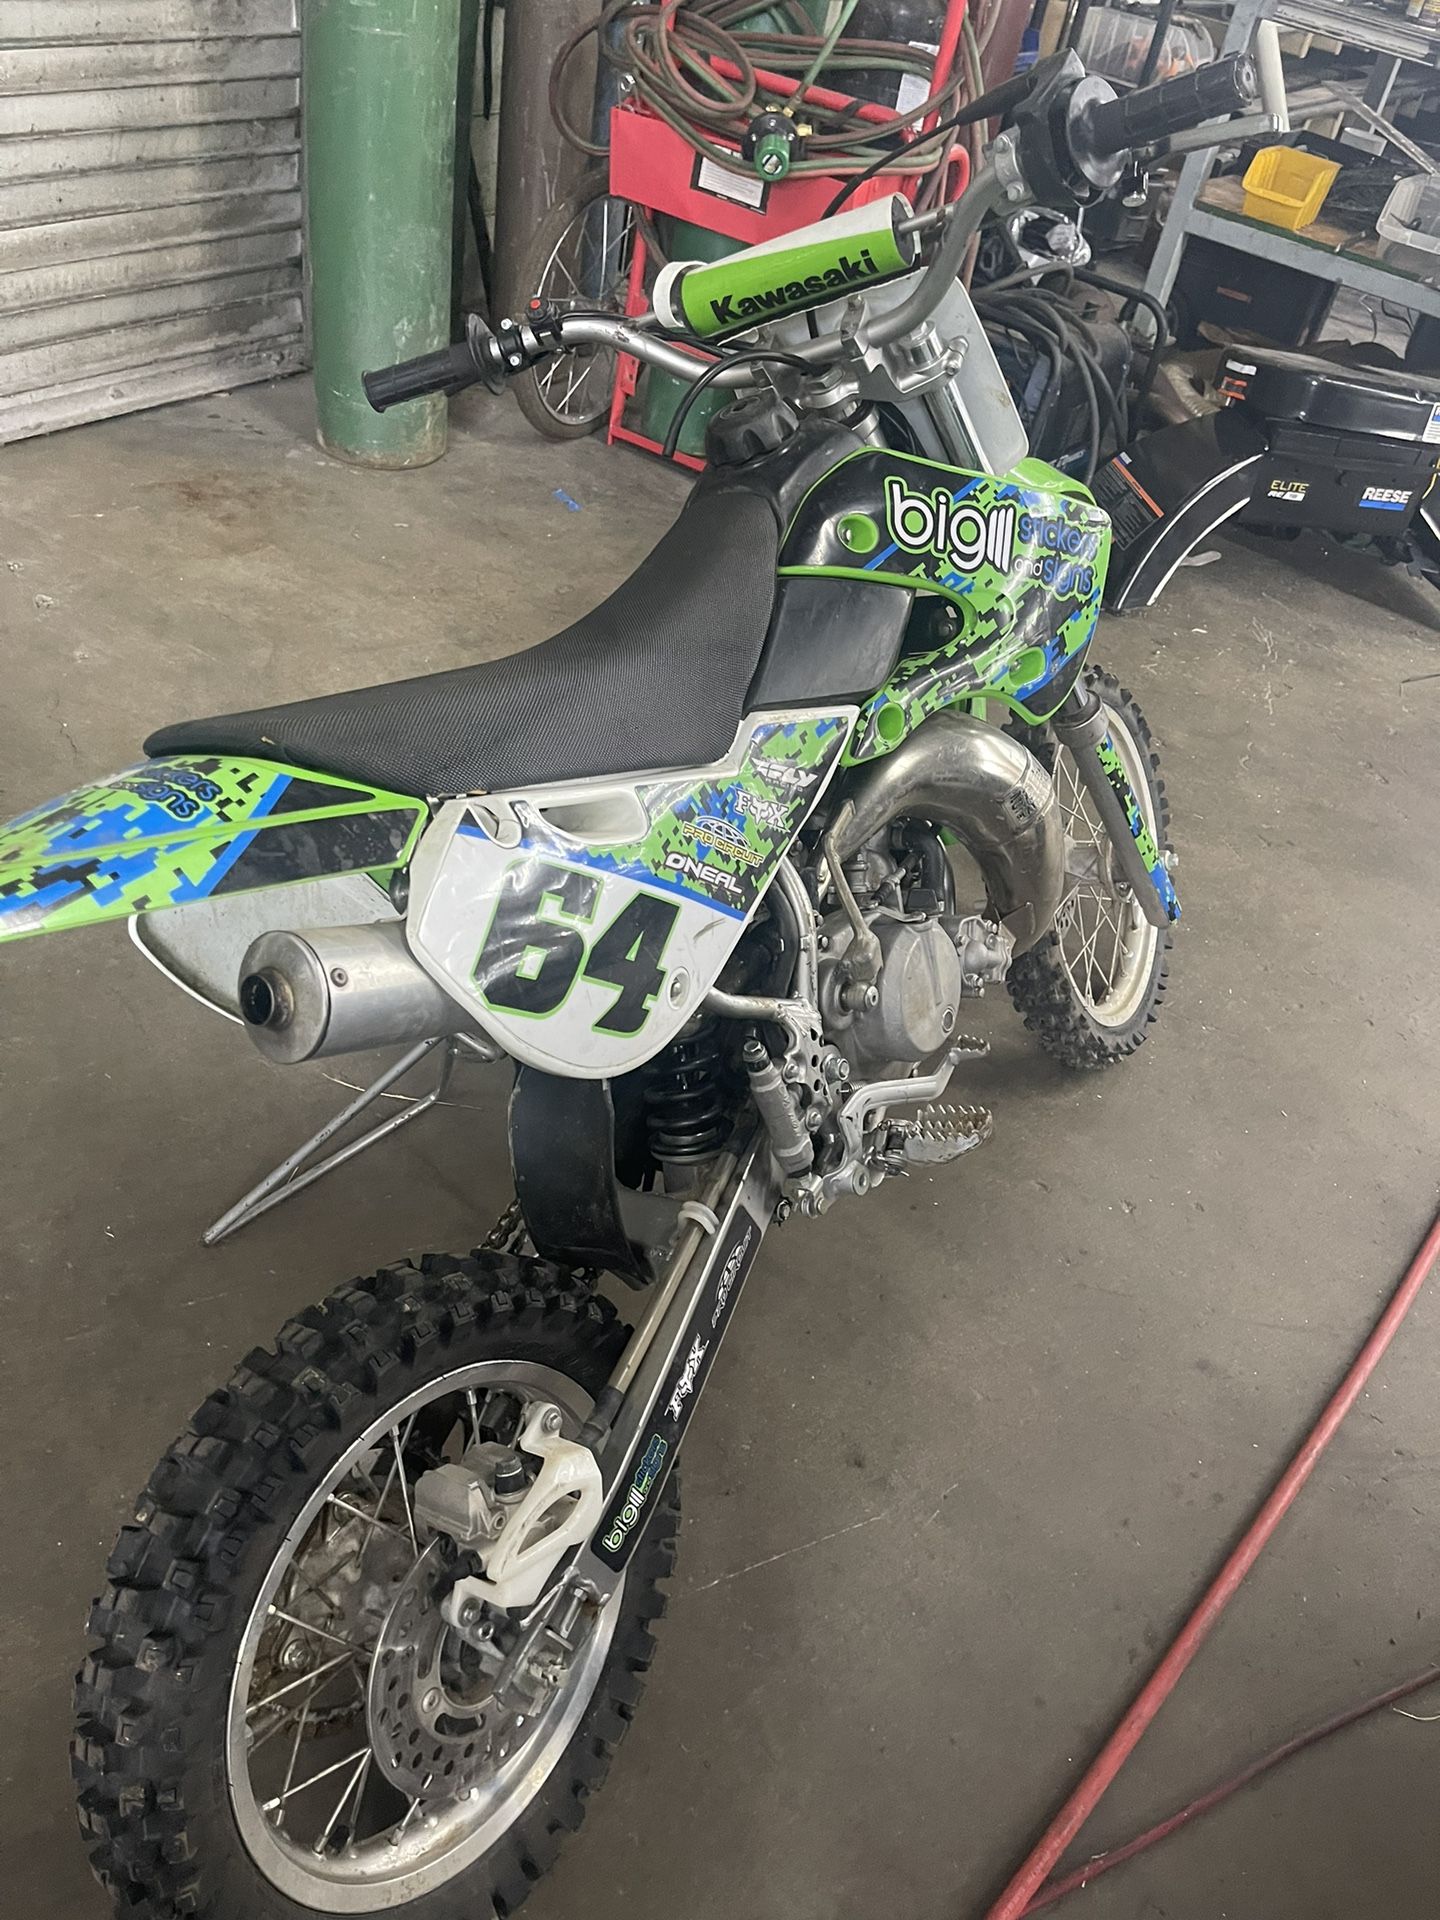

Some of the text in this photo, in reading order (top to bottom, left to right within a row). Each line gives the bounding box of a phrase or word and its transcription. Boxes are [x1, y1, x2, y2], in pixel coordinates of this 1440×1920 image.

[710, 249, 880, 325] Kawasaki
[1271, 479, 1309, 493] ELITE
[1362, 487, 1413, 503] REESE
[1019, 516, 1098, 560] stickers
[683, 824, 764, 867] PRO CIRCUIT
[472, 859, 681, 1037] 64
